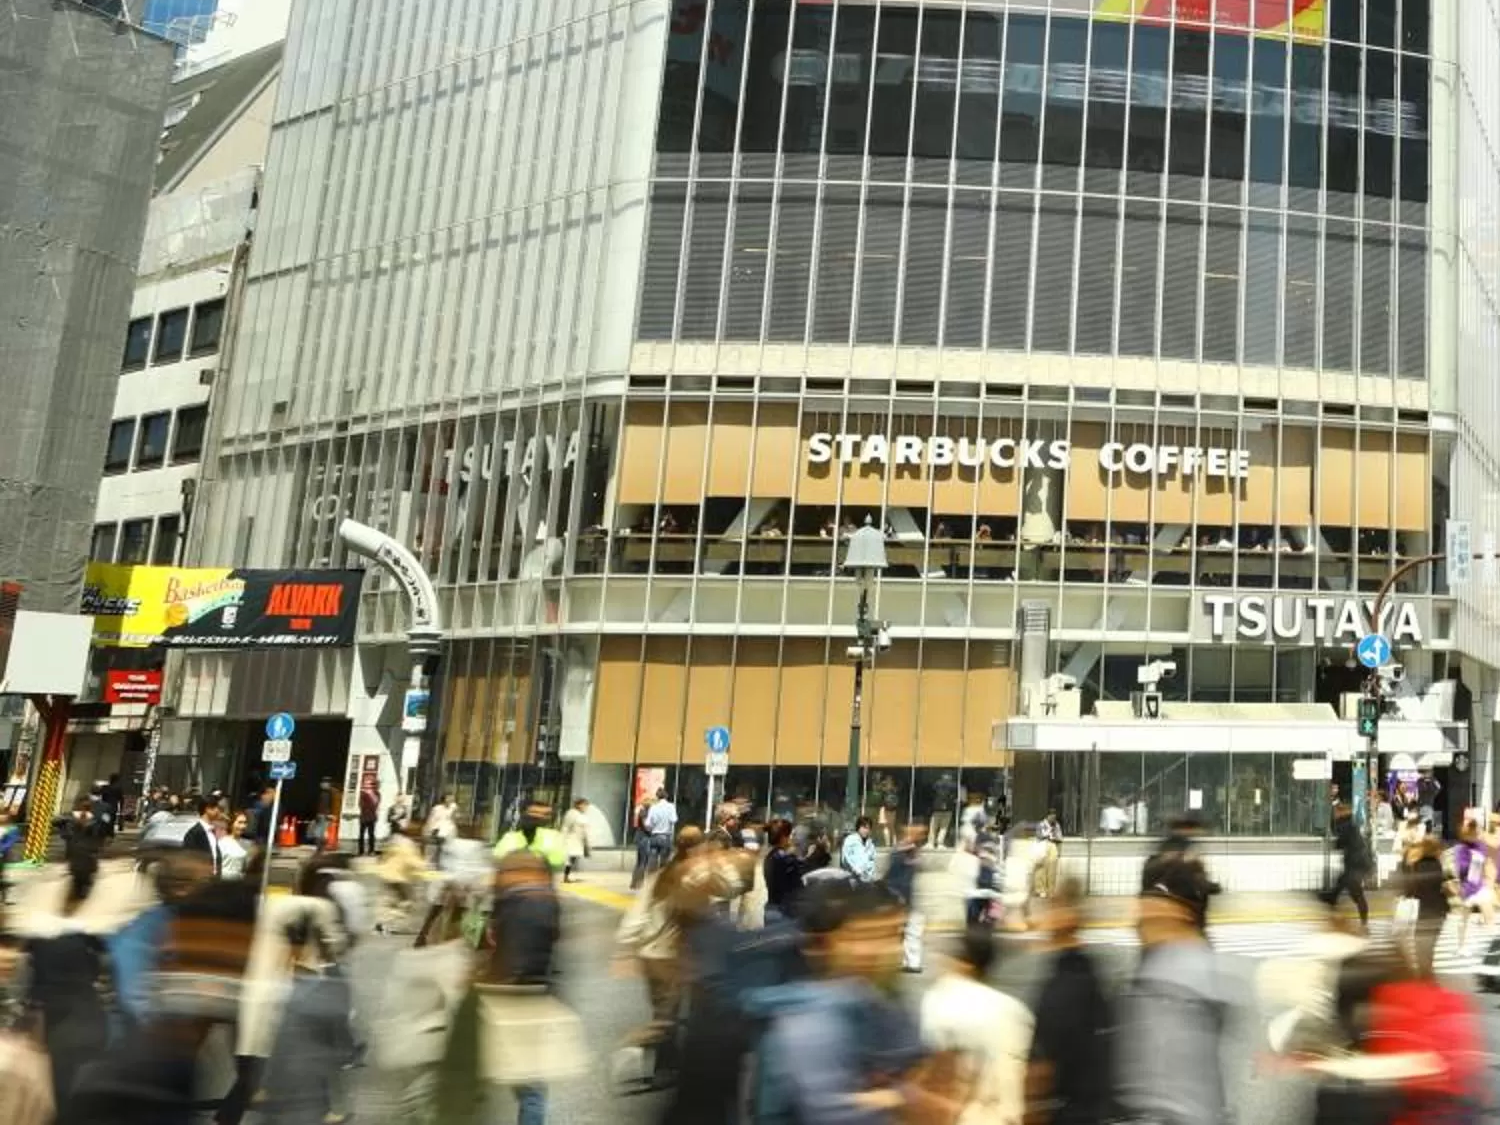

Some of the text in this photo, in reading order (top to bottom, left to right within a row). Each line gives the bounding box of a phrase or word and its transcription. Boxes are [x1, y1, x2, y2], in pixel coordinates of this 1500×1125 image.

[444, 431, 582, 485] TSUTAYA
[808, 433, 1250, 477] STARBUCKS COFFEE
[265, 583, 343, 617] ALVARK
[1205, 595, 1422, 641] TSUTAYA
